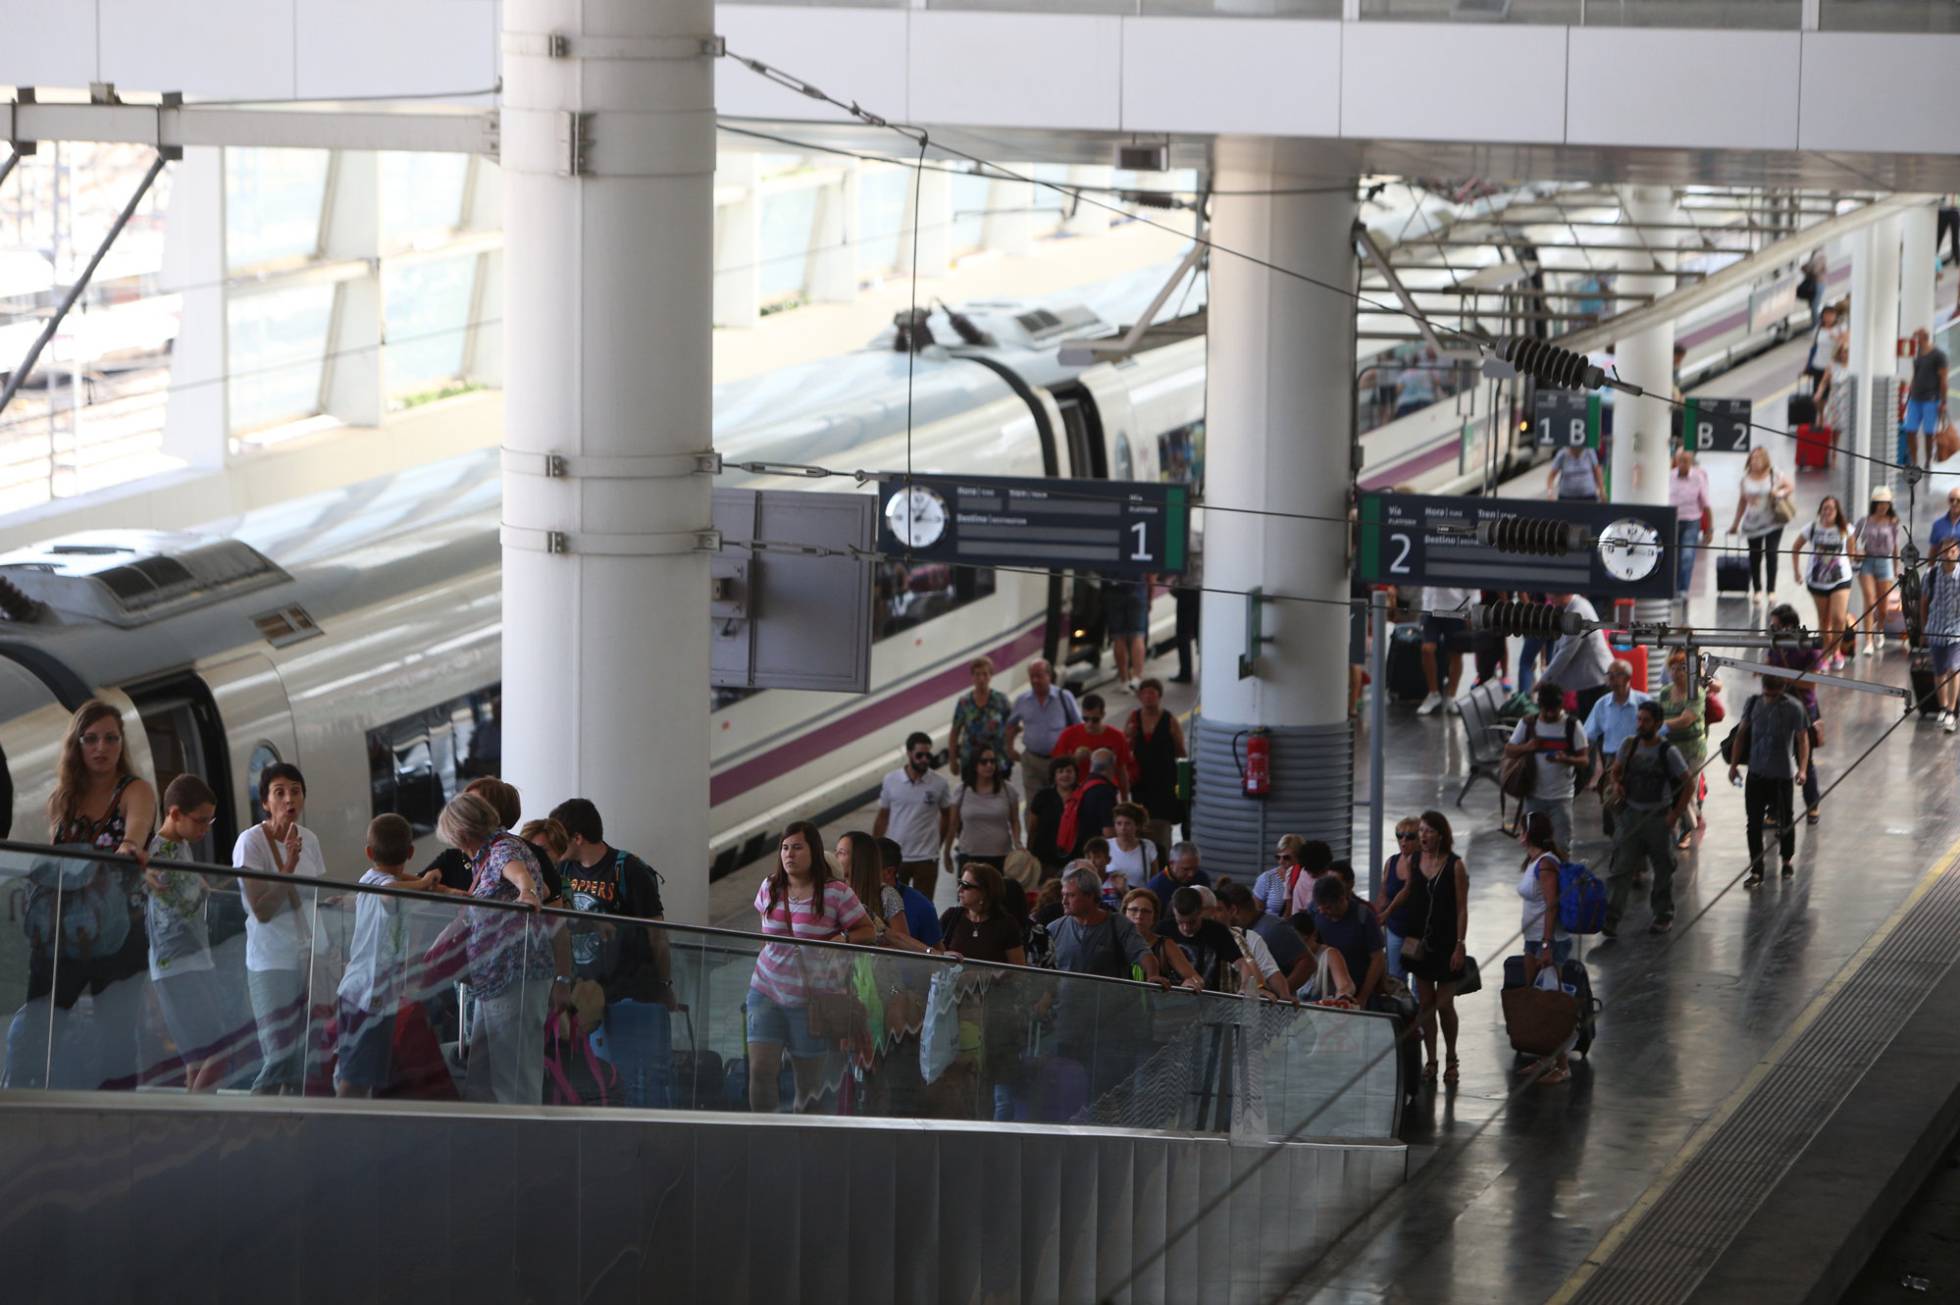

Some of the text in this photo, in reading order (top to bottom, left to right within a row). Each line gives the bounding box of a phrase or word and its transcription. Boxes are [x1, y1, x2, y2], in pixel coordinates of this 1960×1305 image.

[1539, 417, 1586, 446] 1 B
[1697, 421, 1748, 450] B 2
[1478, 509, 1496, 518] Tren
[1130, 521, 1153, 561] 1
[1390, 533, 1412, 574] 2
[1424, 535, 1456, 545] Destino
